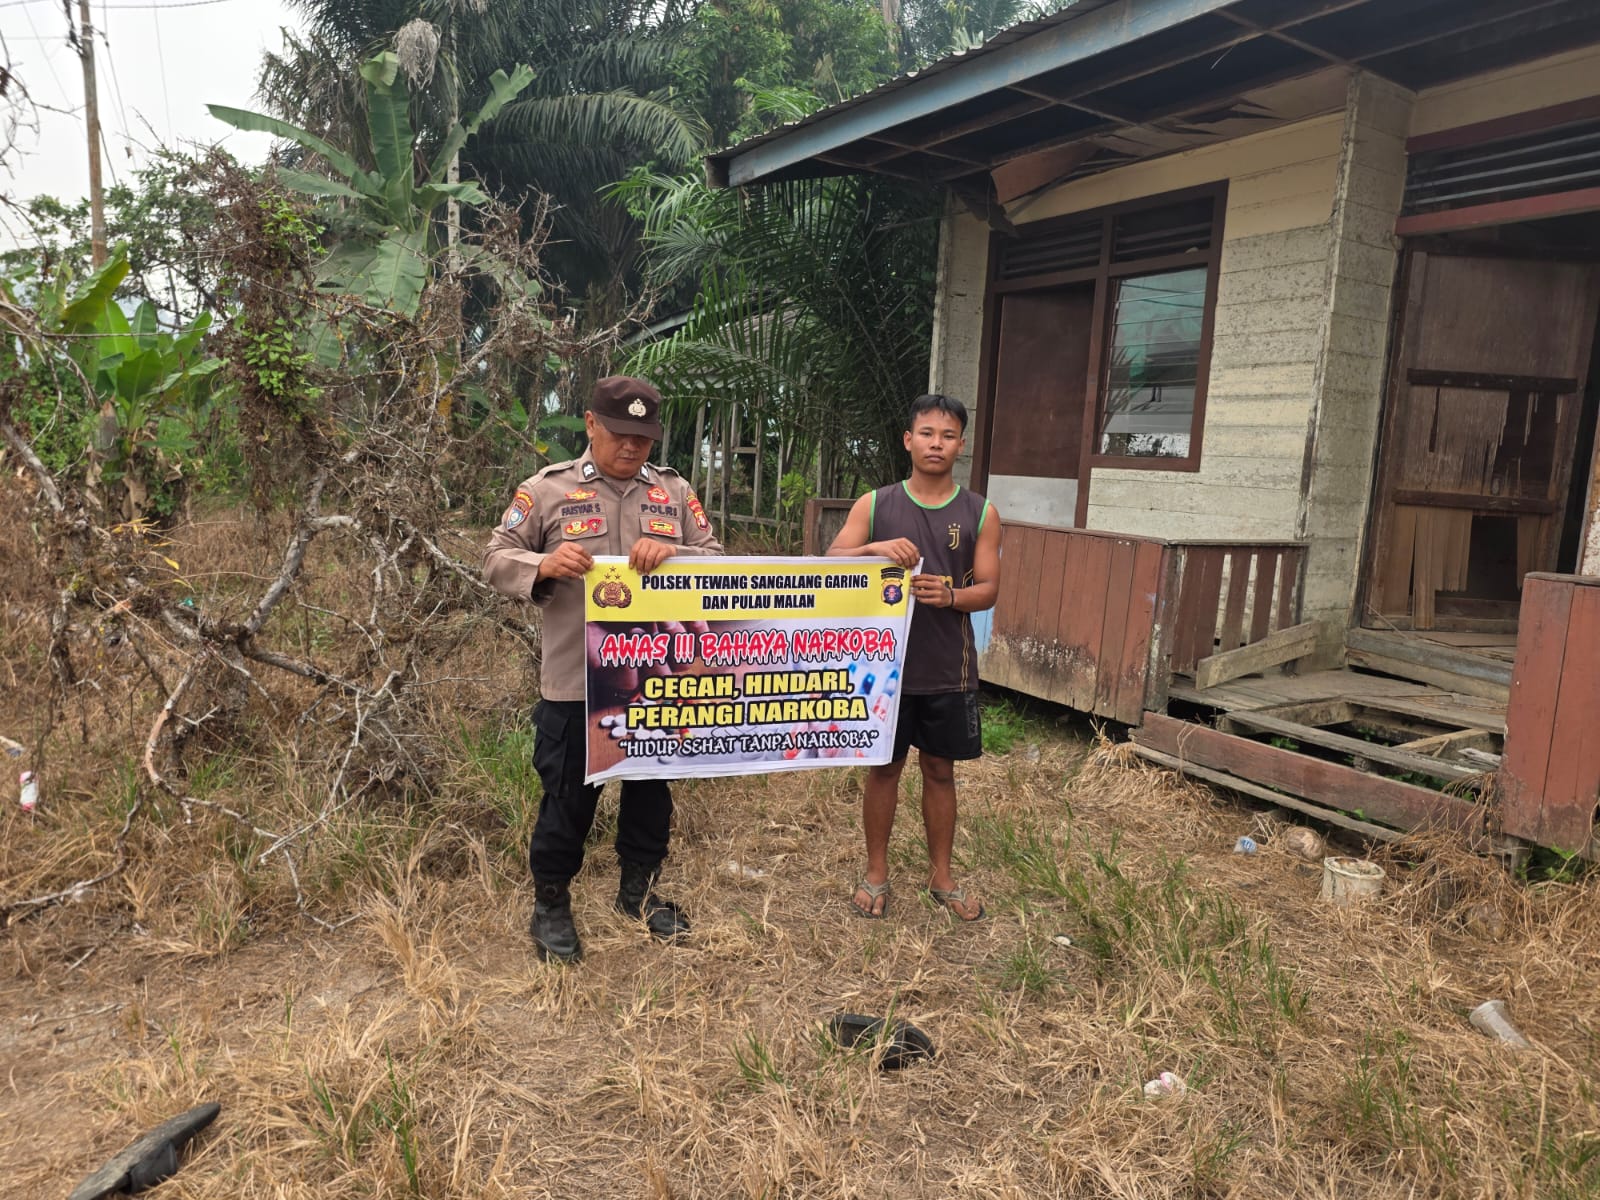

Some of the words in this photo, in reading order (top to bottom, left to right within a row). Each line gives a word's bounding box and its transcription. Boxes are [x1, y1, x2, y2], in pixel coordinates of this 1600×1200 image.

[641, 504, 677, 516] POLRI
[641, 575, 691, 590] POLSEK
[694, 575, 748, 590] TEWANG
[750, 575, 822, 590] SANGALANG
[824, 574, 868, 589] GARING
[702, 595, 729, 610] DAN
[731, 595, 771, 609] PULAU
[773, 594, 815, 608] MALAN
[600, 632, 670, 667] AWAS
[699, 629, 789, 666] BAHAYA
[793, 628, 896, 663] NARKOBA
[643, 675, 741, 699] CEGAH,
[744, 670, 855, 696] HINDARI,
[627, 702, 744, 728] PERANGI
[748, 698, 868, 724] NARKOBA
[619, 738, 679, 757] “HIDUP
[681, 736, 737, 755] SEHAT
[739, 732, 794, 752] TANPA
[796, 730, 879, 749] NARKOBA”
